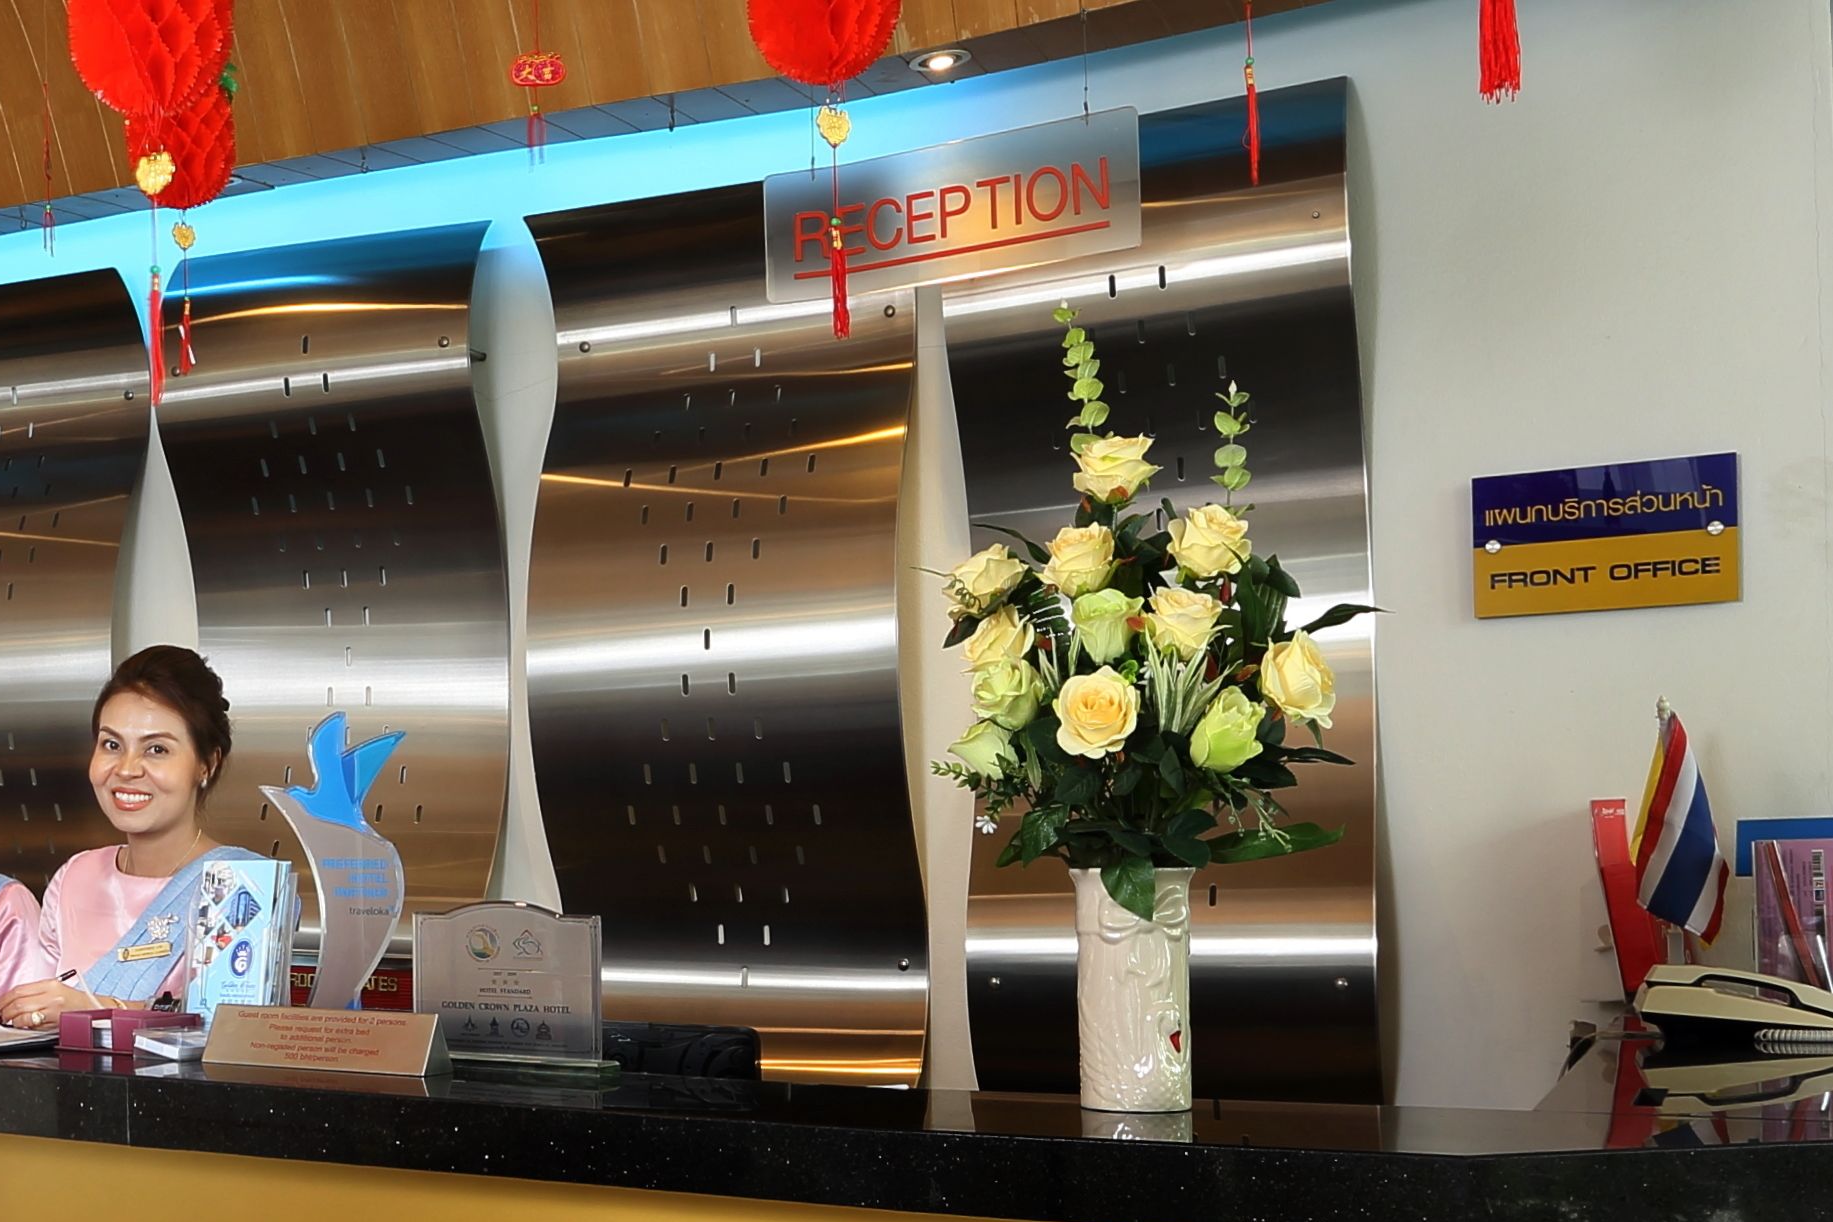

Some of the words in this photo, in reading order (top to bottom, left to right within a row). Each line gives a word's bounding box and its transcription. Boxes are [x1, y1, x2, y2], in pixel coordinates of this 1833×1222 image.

[794, 157, 1111, 263] RECEPTION
[1484, 484, 1724, 527] แผนกบริการส่วนหน้า
[1489, 566, 1597, 590] FRONT
[1609, 556, 1721, 581] OFFICE
[349, 906, 390, 917] traveloka
[290, 972, 316, 988] ROO
[441, 1001, 475, 1010] GOLDEN
[479, 1002, 510, 1011] CROWN
[513, 1003, 539, 1012] PLAZA
[543, 1005, 572, 1014] HOTEL
[238, 1010, 259, 1019] Guest
[281, 1012, 310, 1021] facilities
[325, 1016, 357, 1024] provided
[269, 1023, 294, 1032] Please
[295, 1026, 322, 1034] request
[335, 1027, 355, 1035] extra
